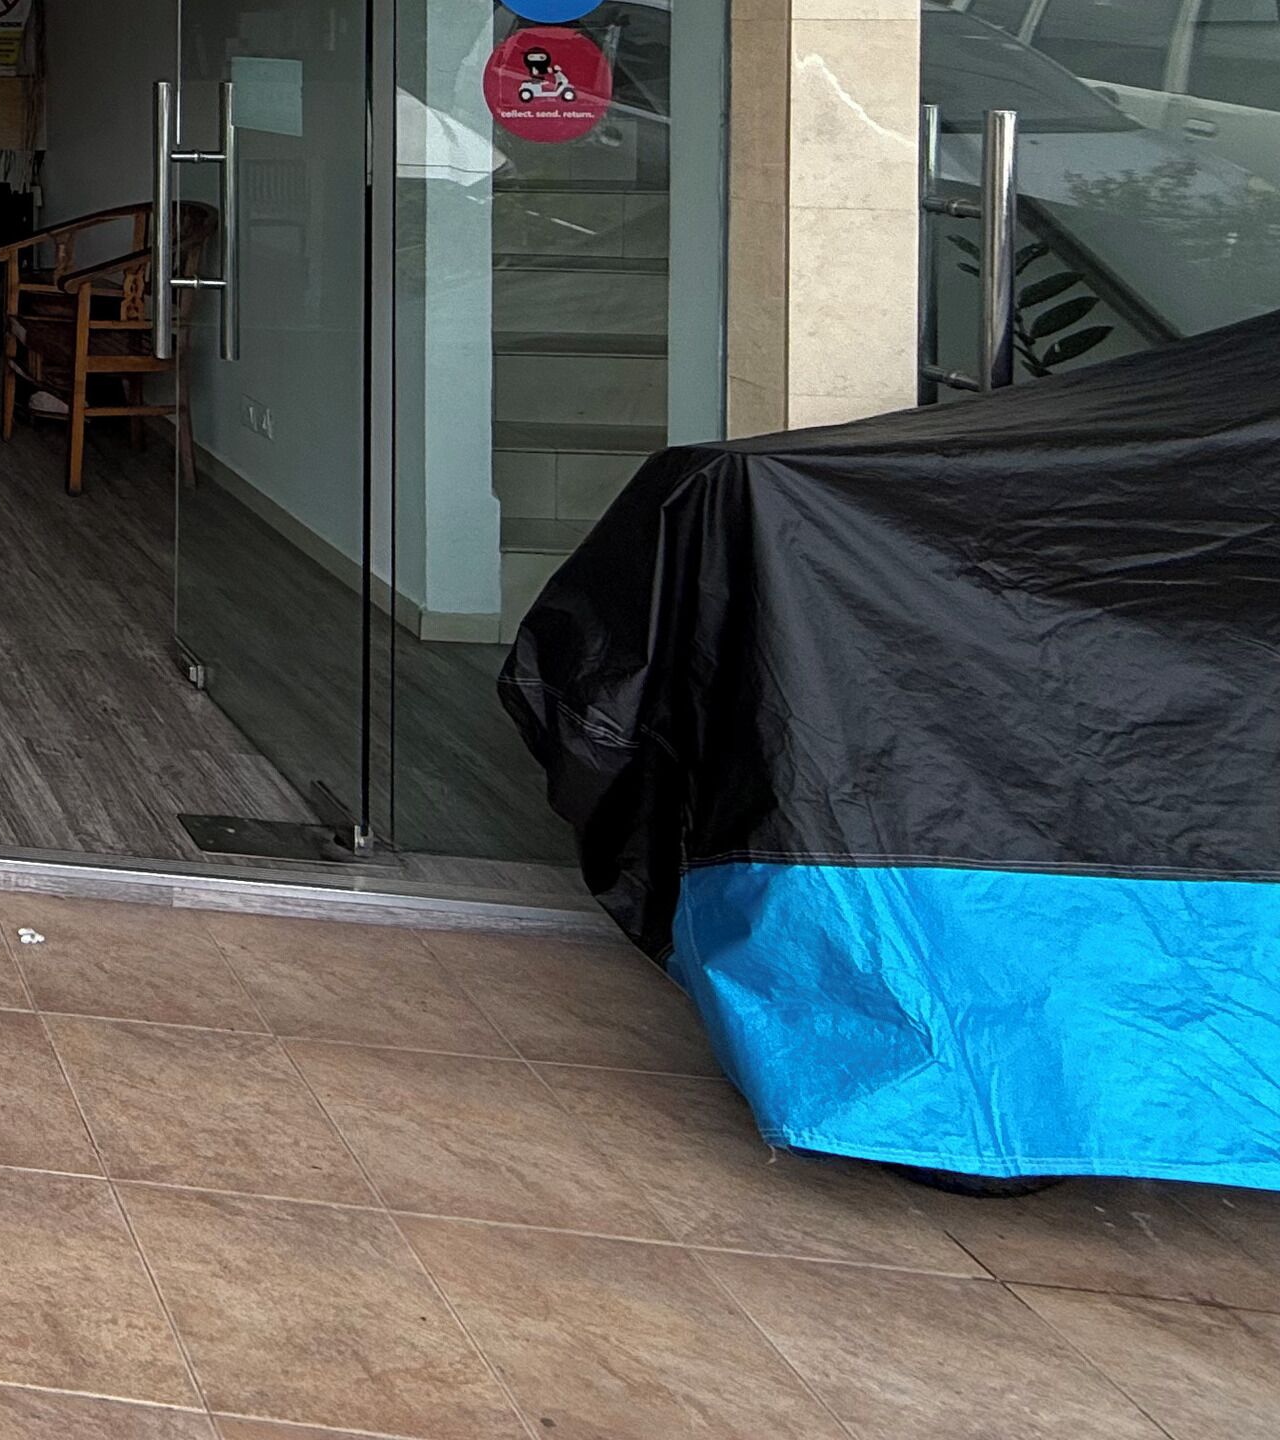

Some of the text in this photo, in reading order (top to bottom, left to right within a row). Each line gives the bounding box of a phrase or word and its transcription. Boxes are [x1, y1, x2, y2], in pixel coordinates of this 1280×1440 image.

[501, 110, 595, 119] collect. send. return.
